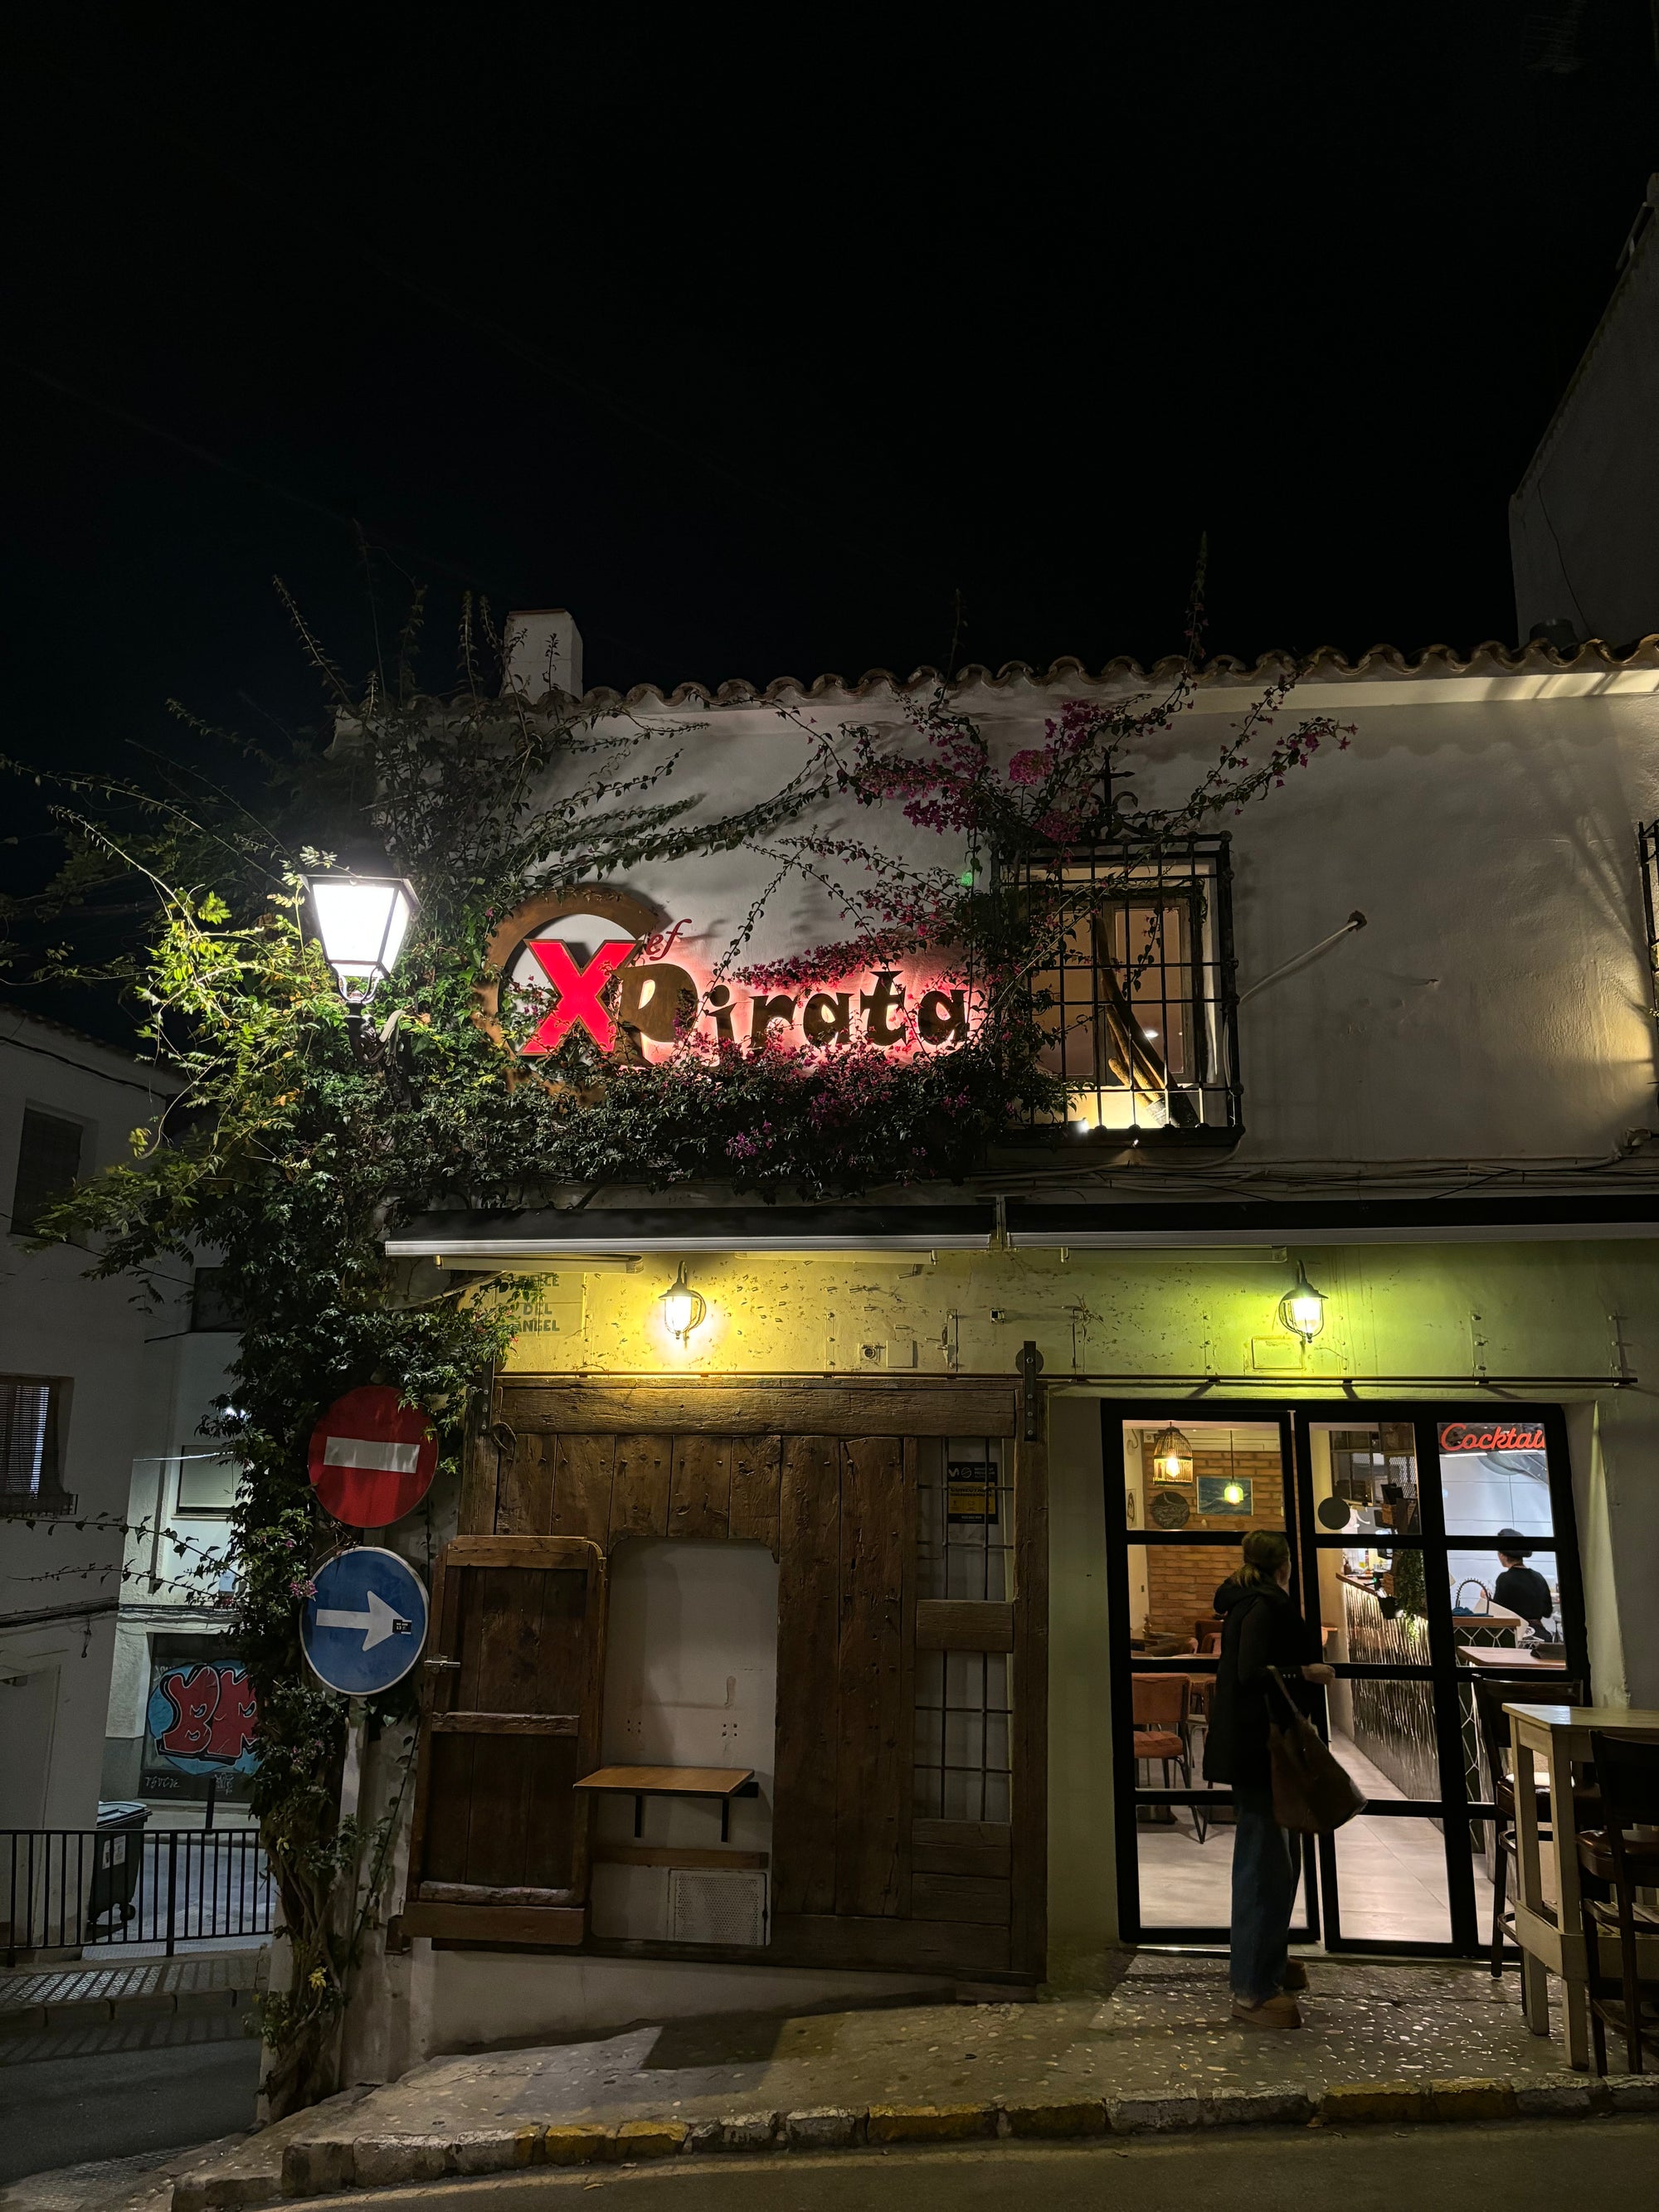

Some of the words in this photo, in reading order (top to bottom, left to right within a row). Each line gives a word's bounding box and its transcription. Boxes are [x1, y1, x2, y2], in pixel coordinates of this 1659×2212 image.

[607, 963, 970, 1067] Pirata
[518, 1275, 560, 1287] LLE
[1441, 1423, 1545, 1451] Cocktai
